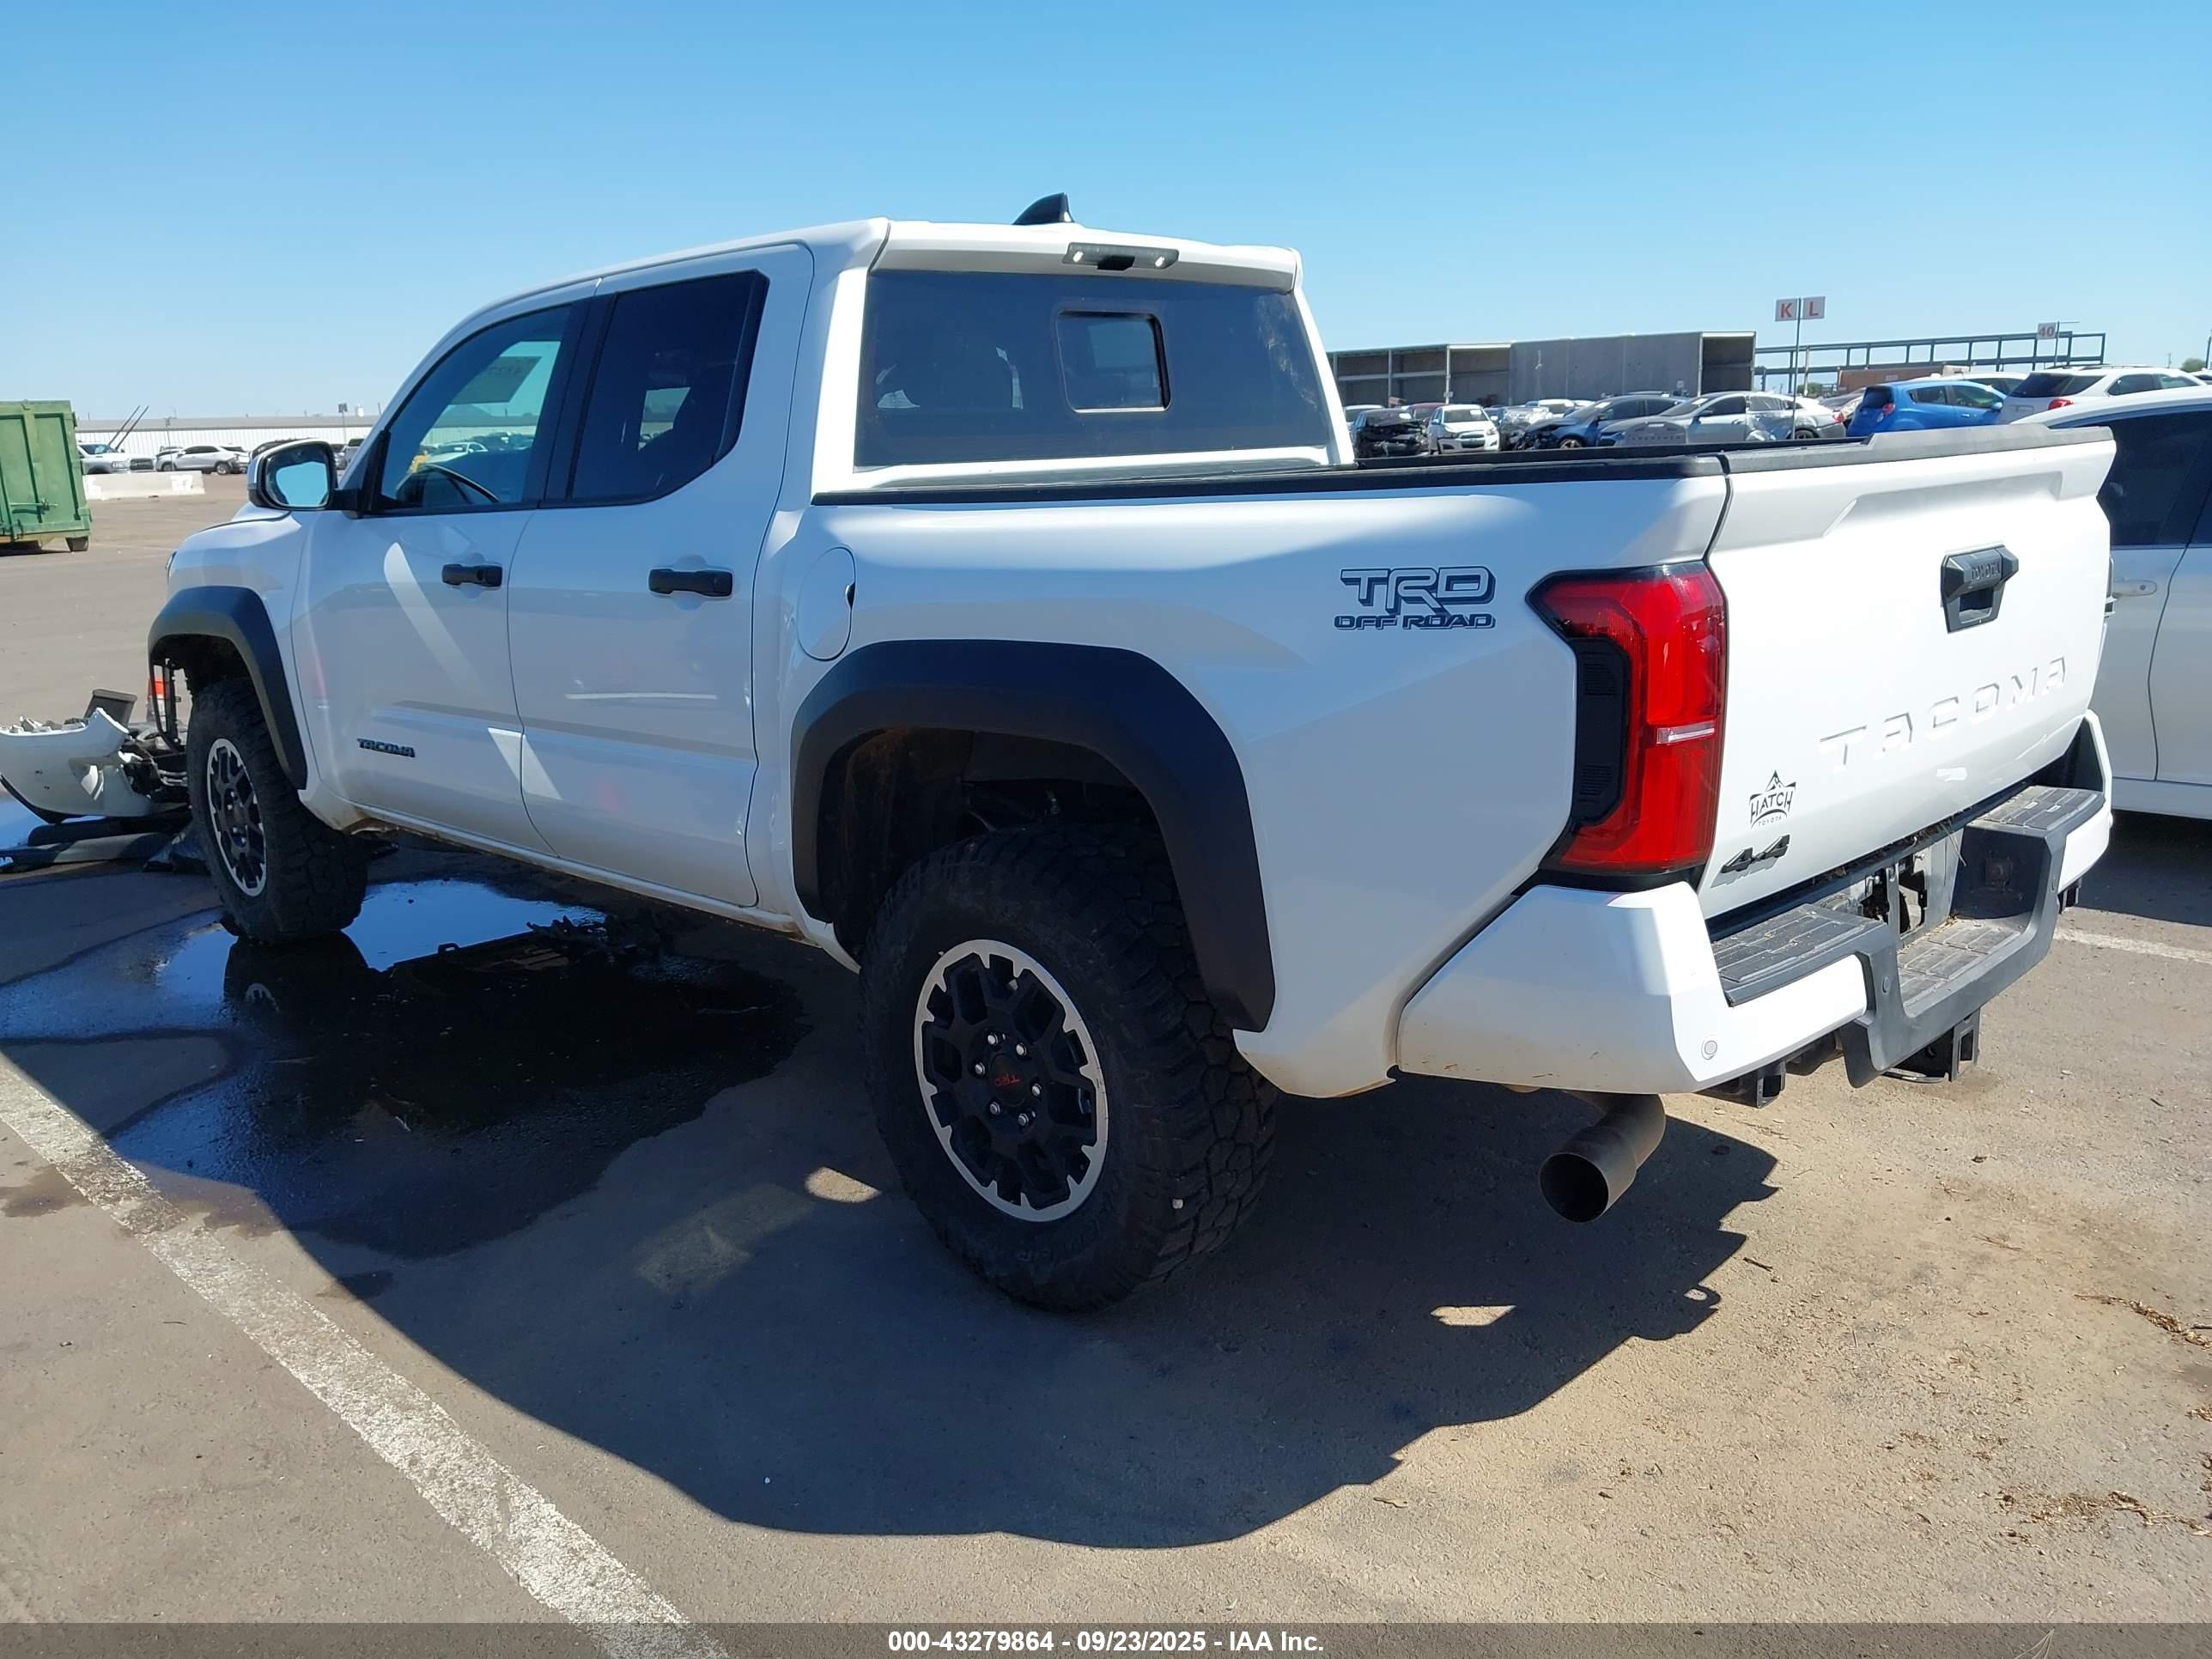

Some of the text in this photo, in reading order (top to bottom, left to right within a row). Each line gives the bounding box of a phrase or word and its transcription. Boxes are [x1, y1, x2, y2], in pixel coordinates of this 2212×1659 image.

[1780, 301, 1793, 319] K
[1809, 301, 1819, 317] L
[2039, 326, 2055, 337] 40
[1340, 565, 1496, 616] TRD
[1334, 613, 1496, 630] OFF ROAD
[1819, 655, 2068, 769] TACOMA
[356, 738, 416, 758] TACOMA
[1749, 790, 1794, 824] HATCH
[1758, 815, 1783, 828] TOYOTA
